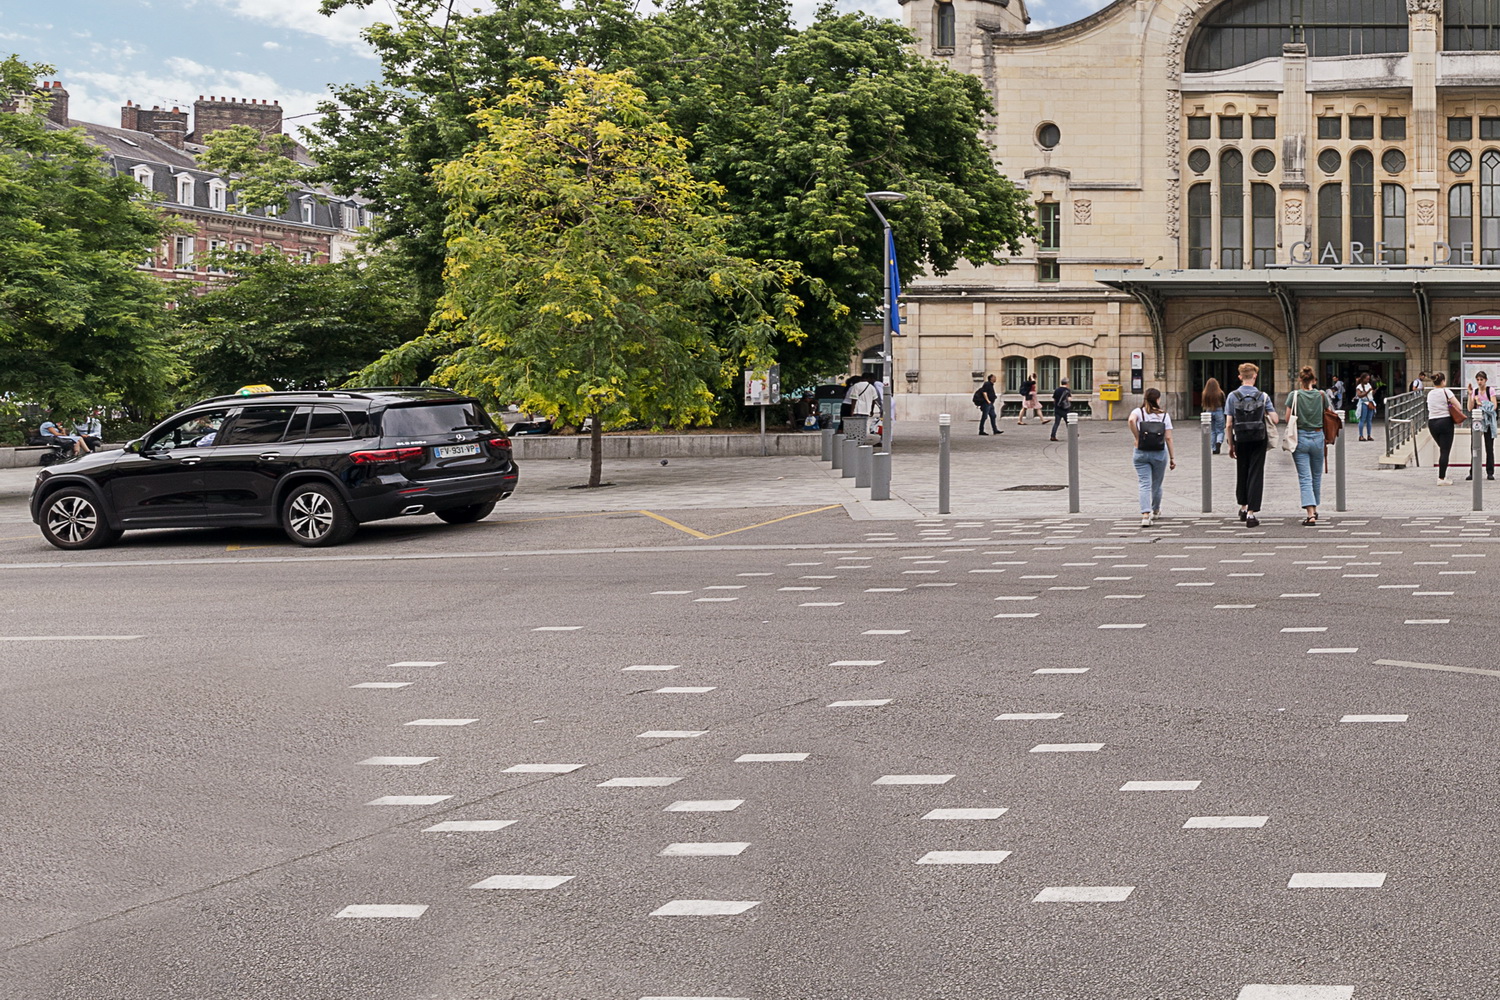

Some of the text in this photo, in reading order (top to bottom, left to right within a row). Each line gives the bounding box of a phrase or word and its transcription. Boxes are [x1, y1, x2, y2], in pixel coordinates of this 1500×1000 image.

[1289, 241, 1389, 265] GARE
[1433, 241, 1475, 265] DE
[1016, 316, 1079, 326] BUFFET
